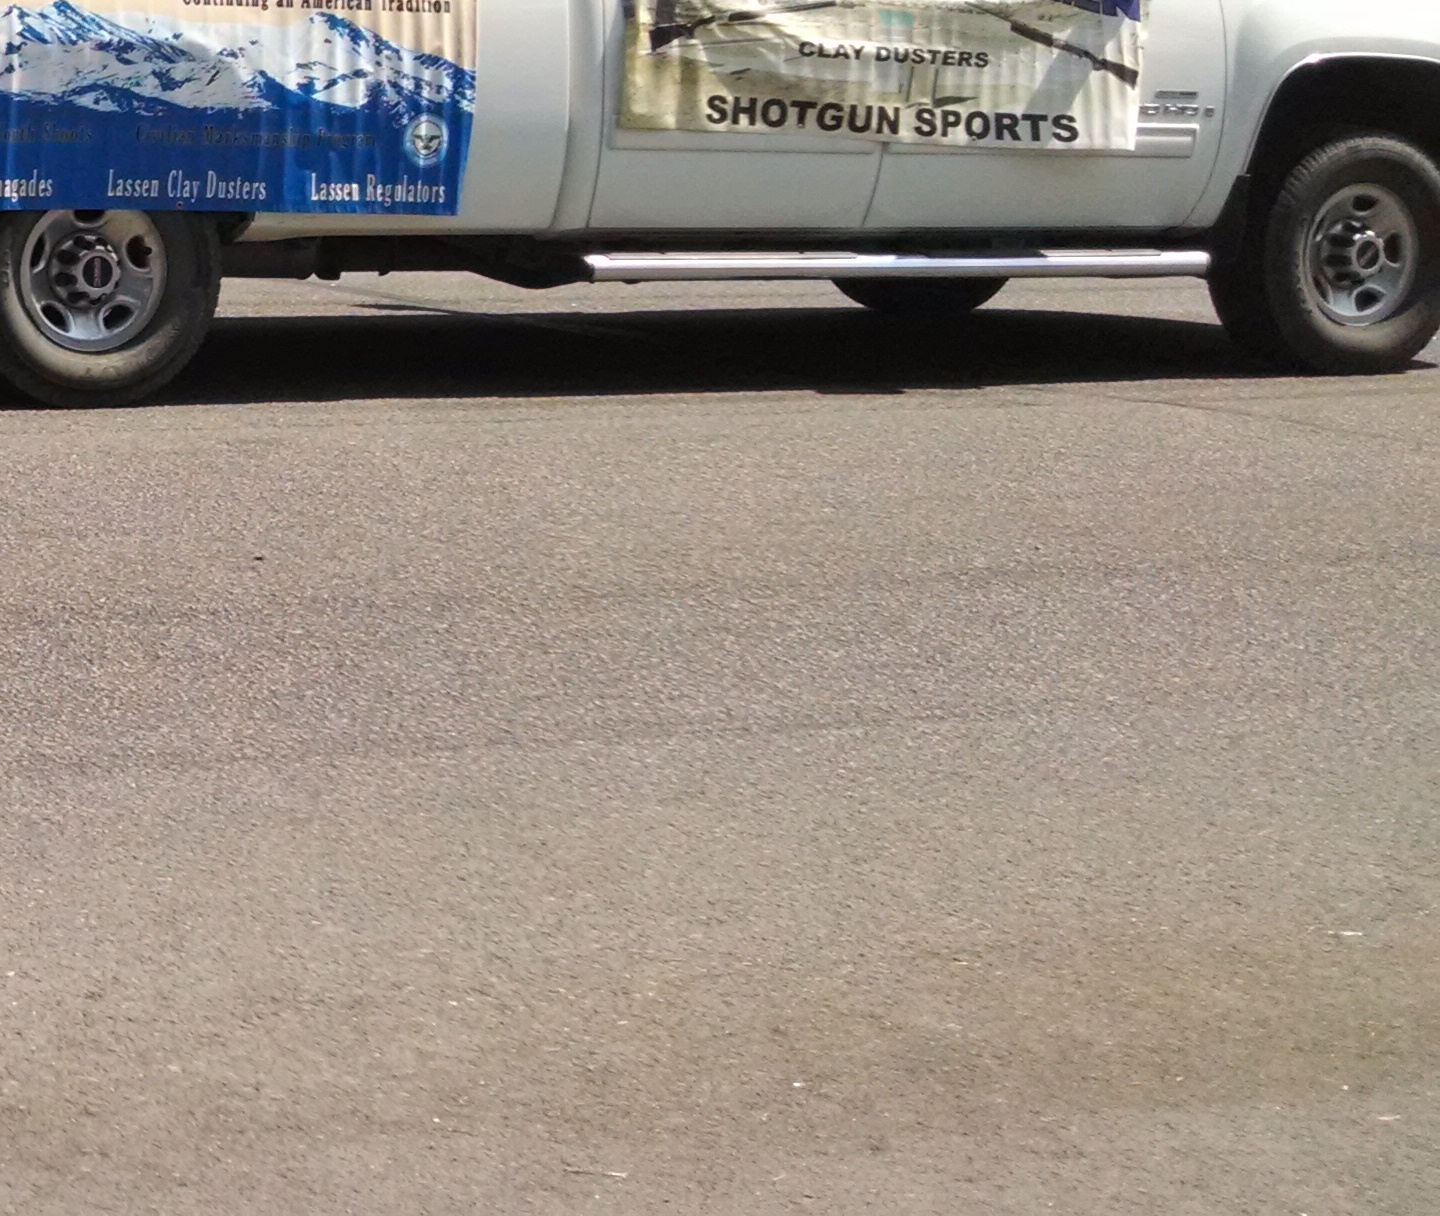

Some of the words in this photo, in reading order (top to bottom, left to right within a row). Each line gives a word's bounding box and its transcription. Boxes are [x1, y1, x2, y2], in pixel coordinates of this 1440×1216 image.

[798, 41, 865, 60] CLAY
[875, 46, 989, 68] DUSTERS
[706, 94, 900, 135] SHOTGUN
[915, 107, 1079, 143] SPORTS
[107, 169, 159, 197] Lassen
[168, 170, 200, 203] Clay
[205, 171, 267, 200] Dusters
[311, 173, 360, 201] Lassen
[366, 174, 446, 207] Regulators
